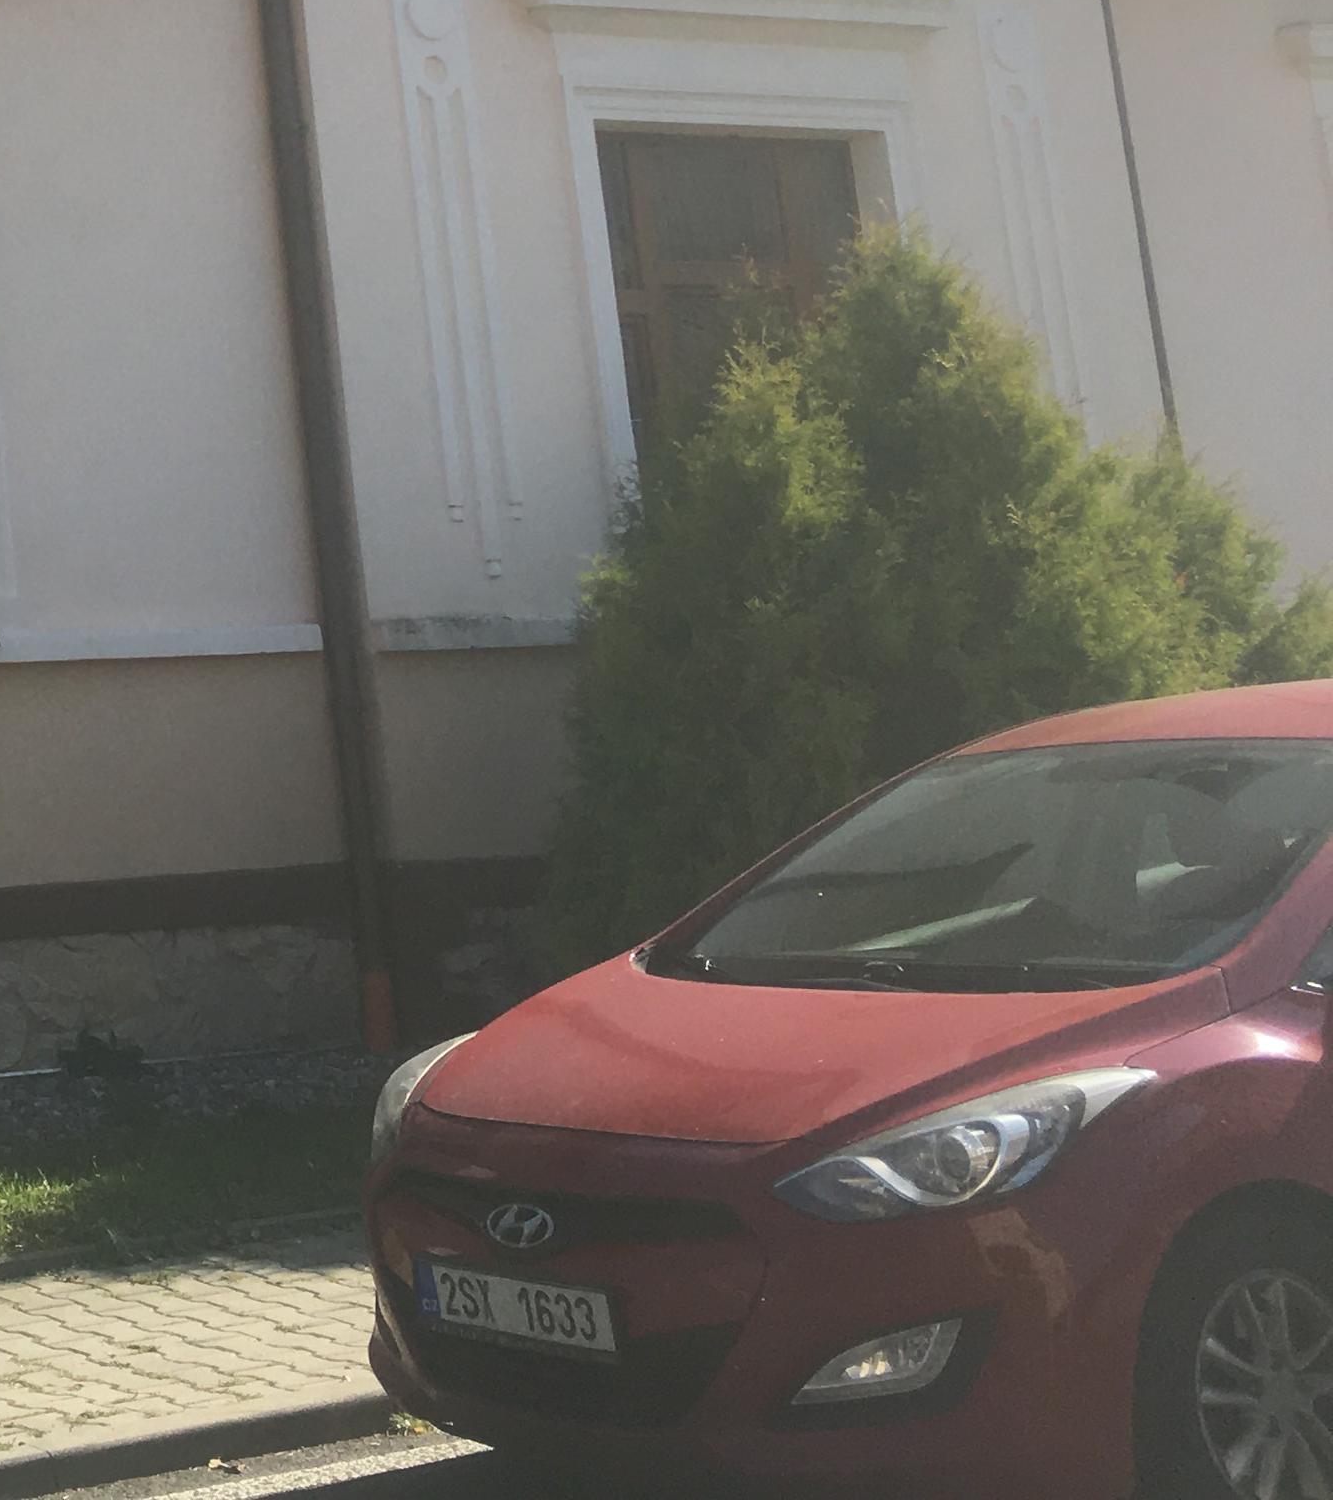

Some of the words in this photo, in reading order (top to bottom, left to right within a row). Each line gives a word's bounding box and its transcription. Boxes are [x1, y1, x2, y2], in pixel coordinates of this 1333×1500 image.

[421, 1297, 440, 1311] CZ
[440, 1271, 496, 1323] 2SX
[517, 1287, 598, 1341] 1633
